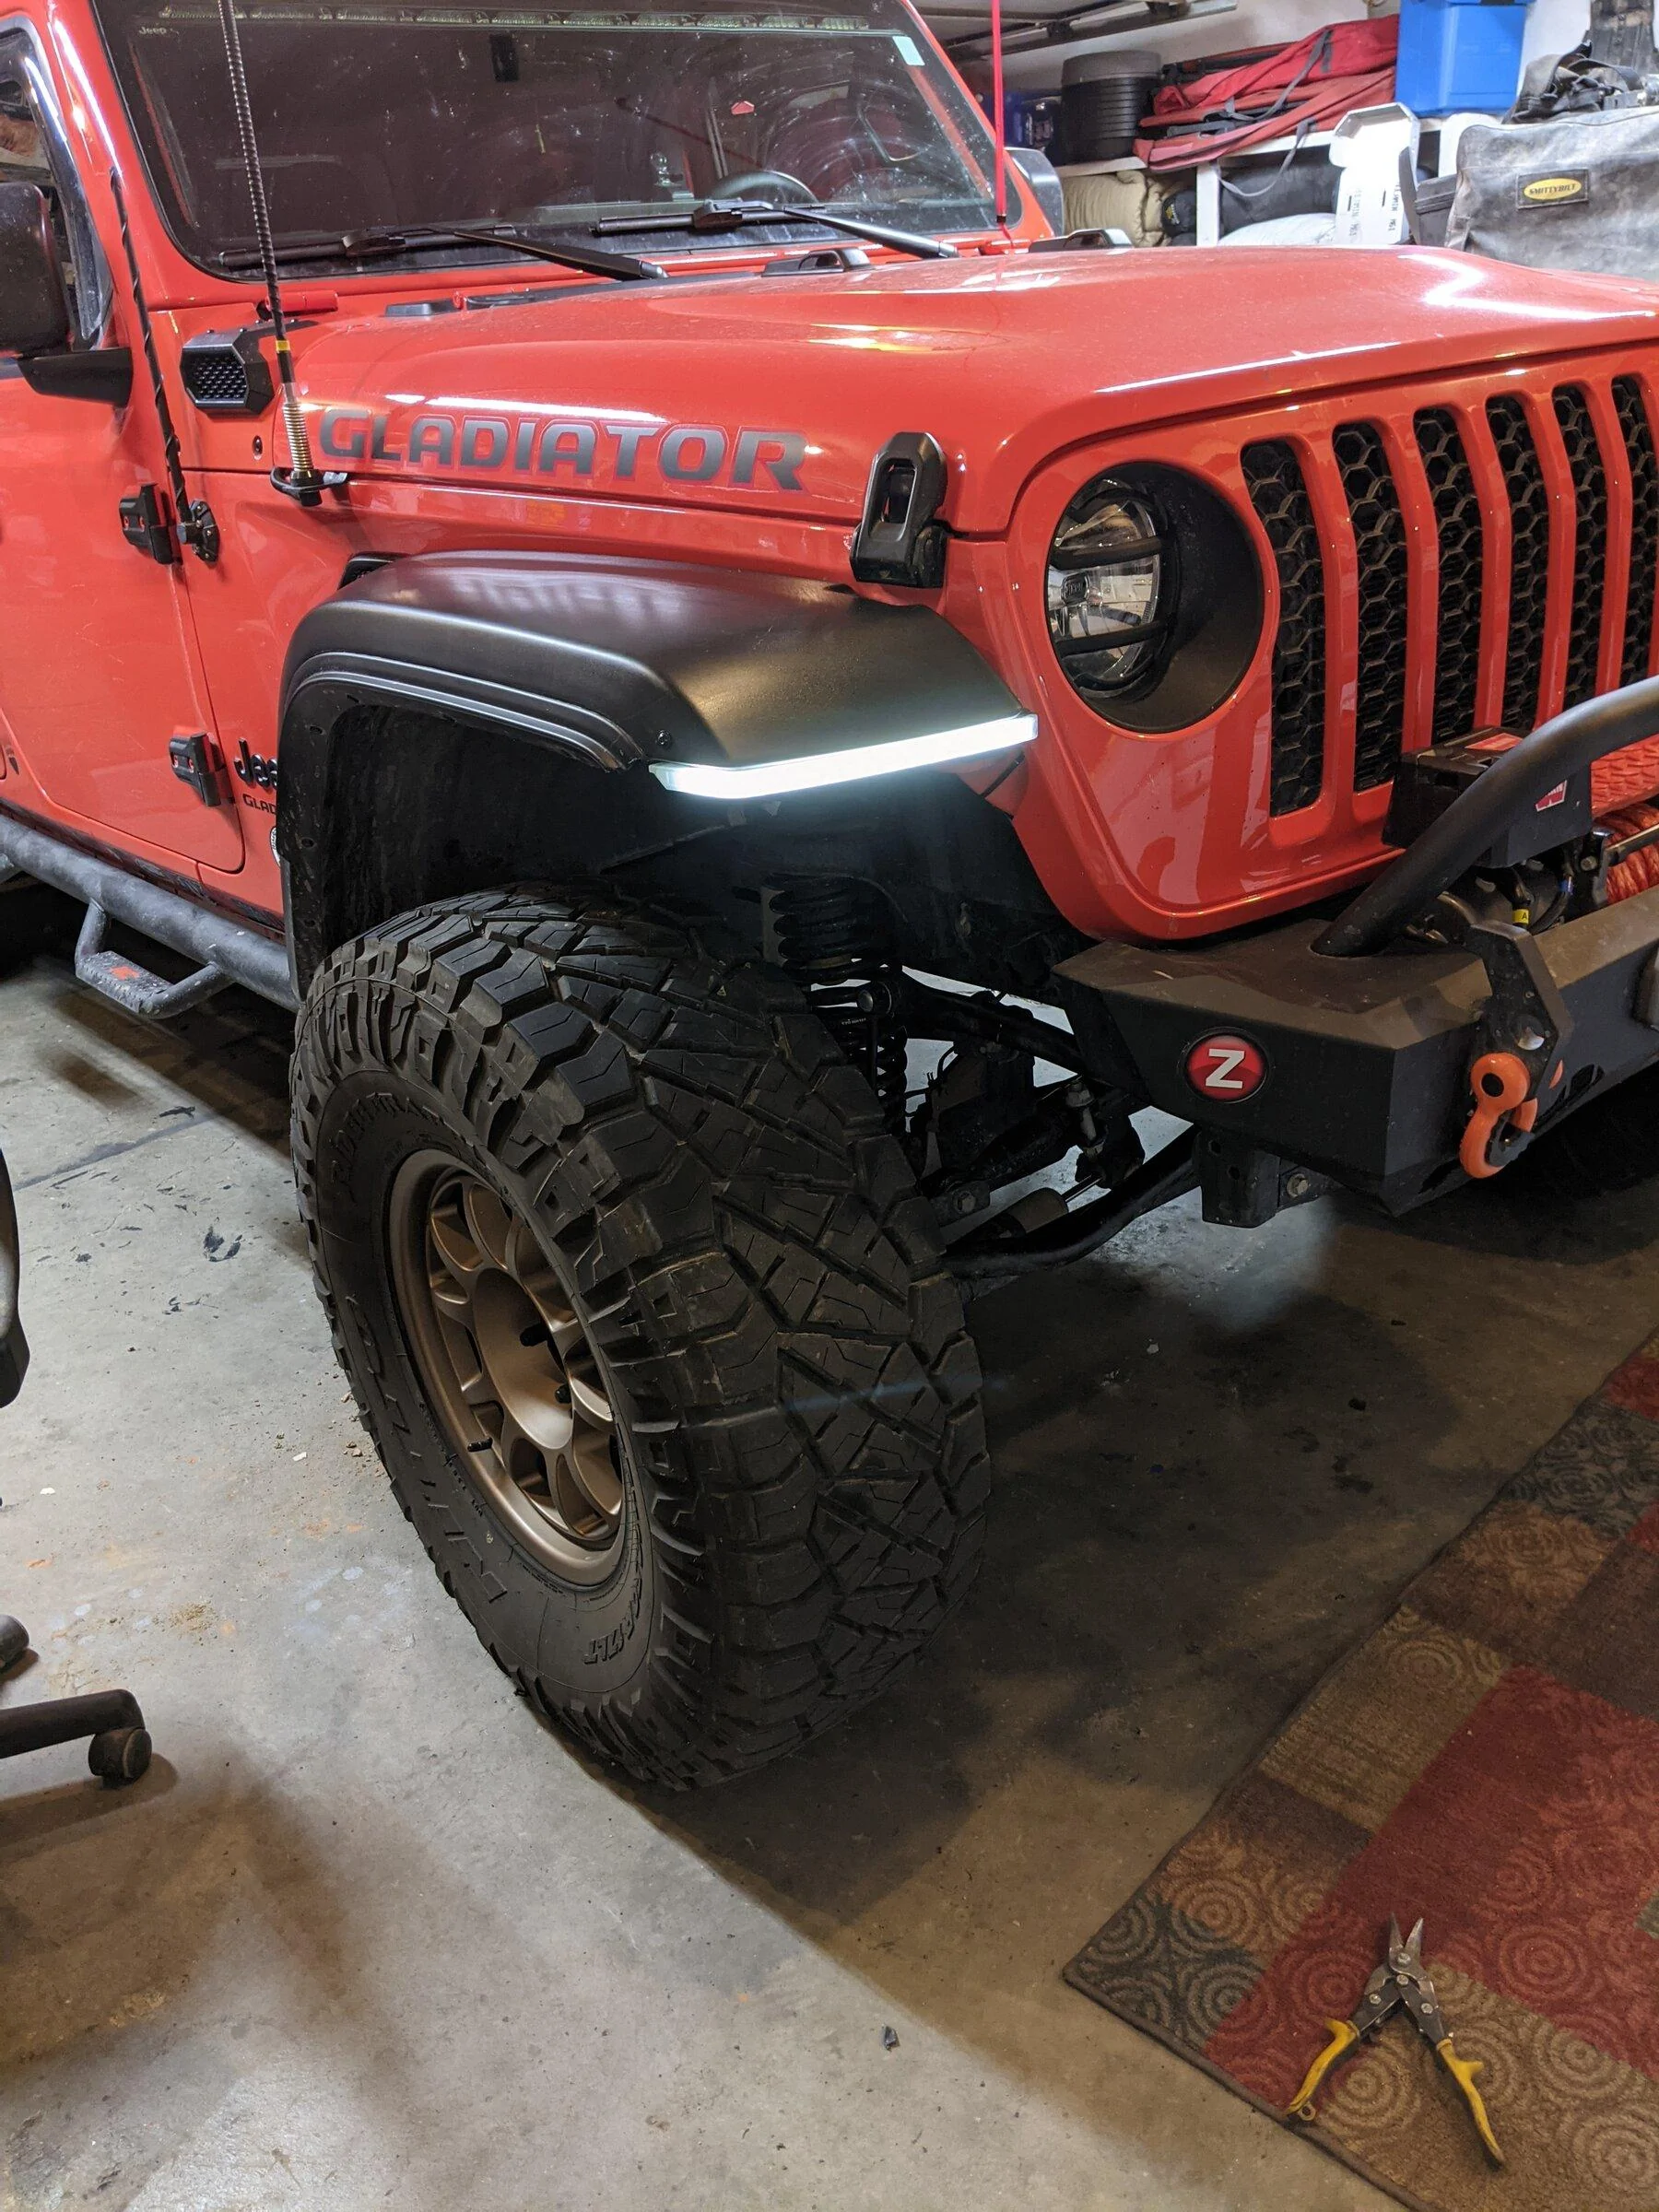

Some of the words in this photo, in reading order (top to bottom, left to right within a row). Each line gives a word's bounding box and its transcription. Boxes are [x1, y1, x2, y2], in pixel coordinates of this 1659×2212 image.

[1530, 183, 1576, 194] SMITTYBILT
[318, 407, 809, 491] GLADIATOR
[233, 737, 277, 791] Jee
[242, 793, 276, 815] GLAD
[1206, 1048, 1245, 1089] Z
